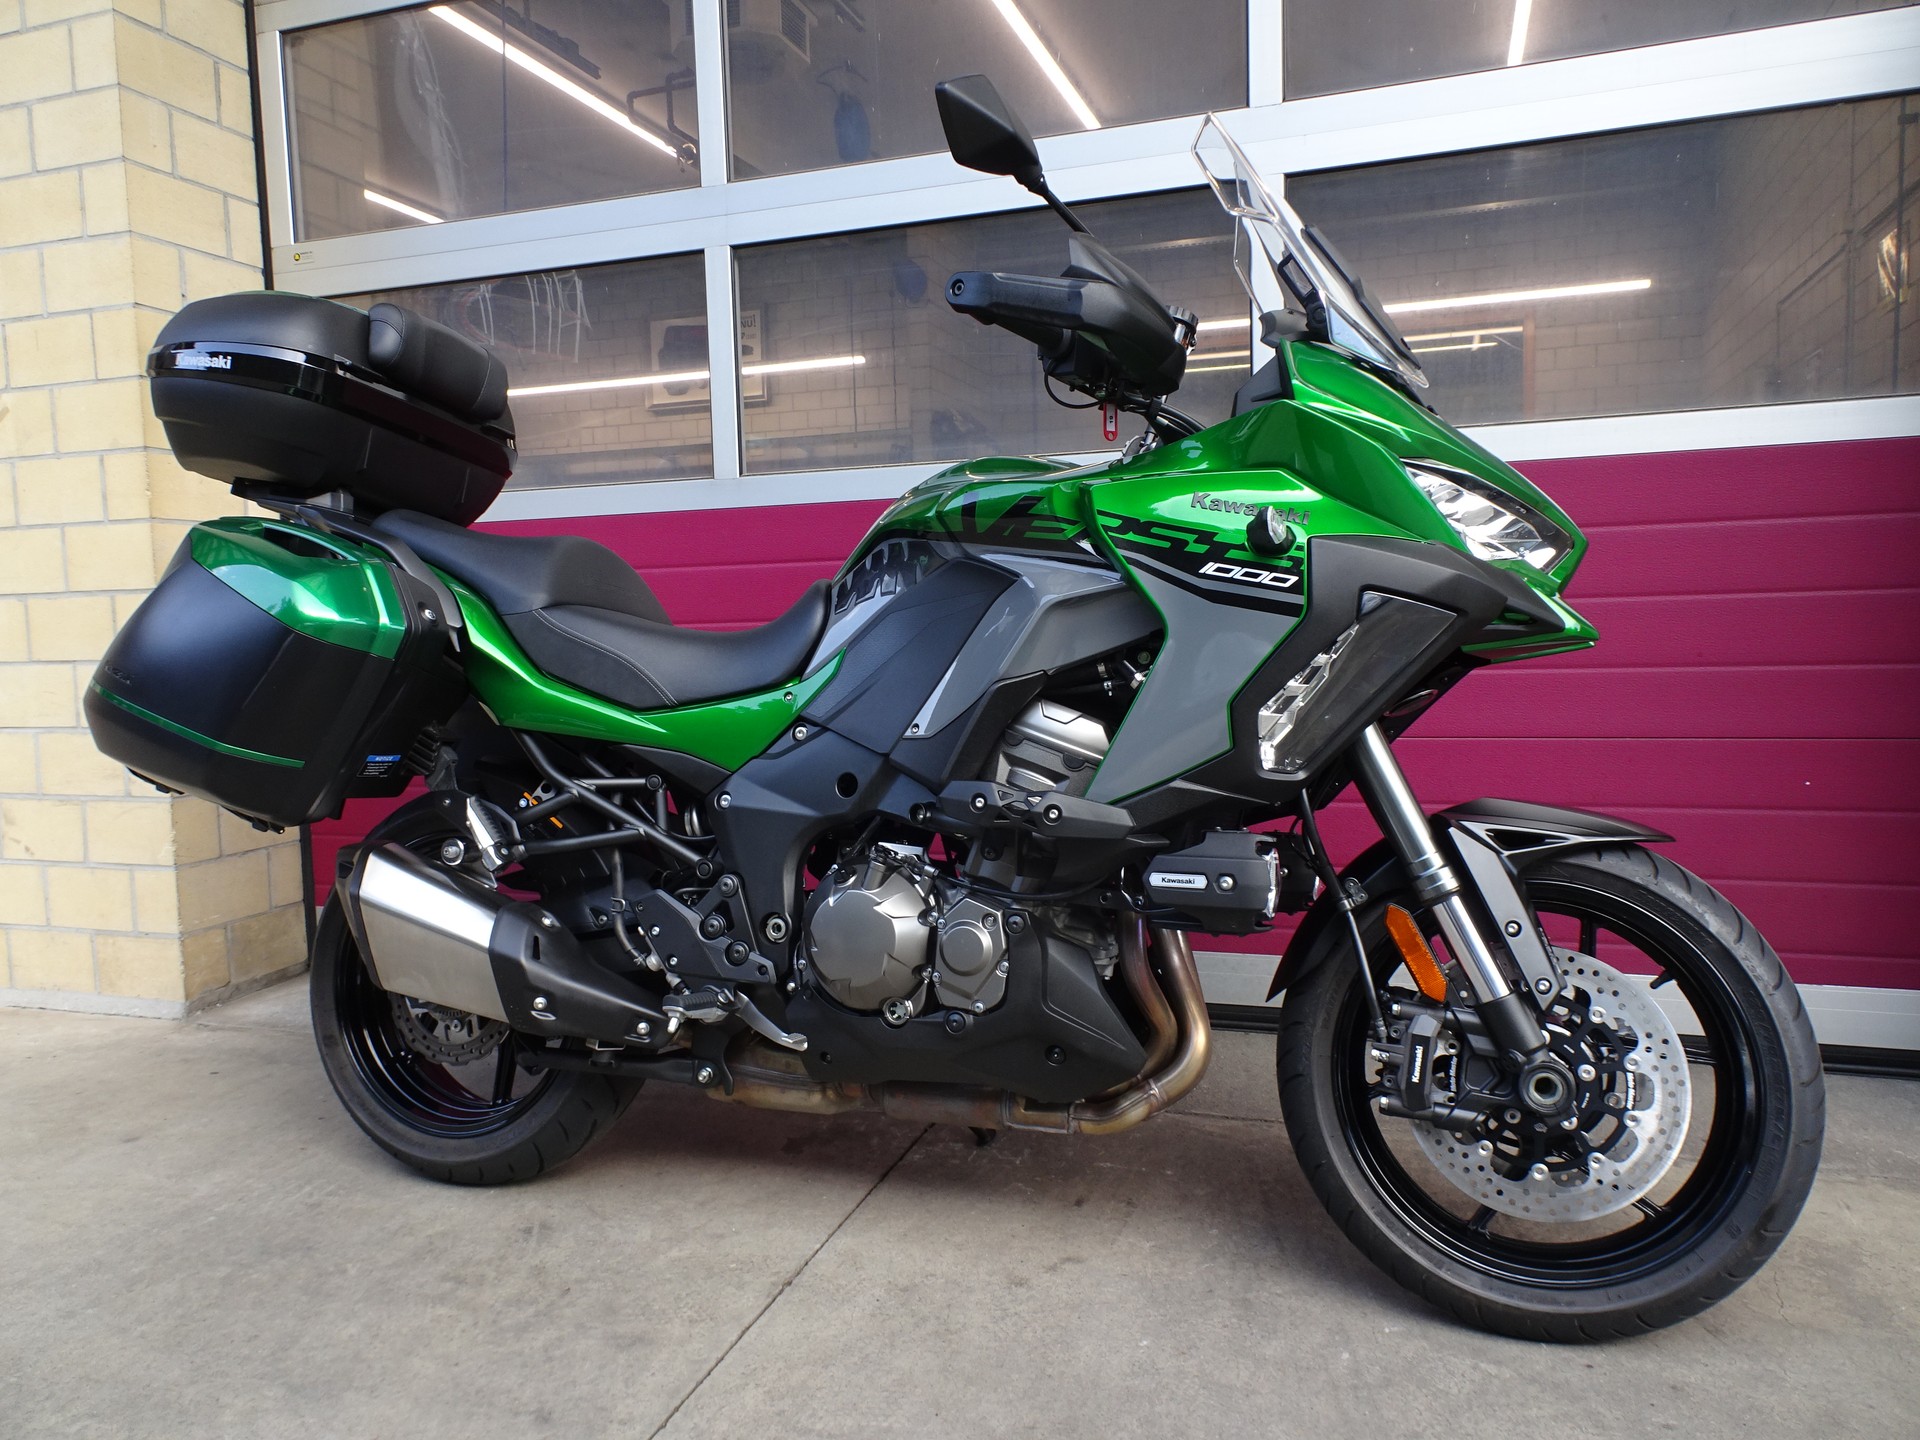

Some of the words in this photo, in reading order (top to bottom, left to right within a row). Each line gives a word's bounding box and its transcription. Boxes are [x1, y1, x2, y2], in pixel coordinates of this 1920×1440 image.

[175, 353, 232, 369] Kawasaki
[1191, 491, 1311, 525] Kawaaki
[1198, 562, 1299, 588] 1000
[1161, 876, 1196, 885] Kawasaki
[1411, 1045, 1424, 1083] Kawasaki
